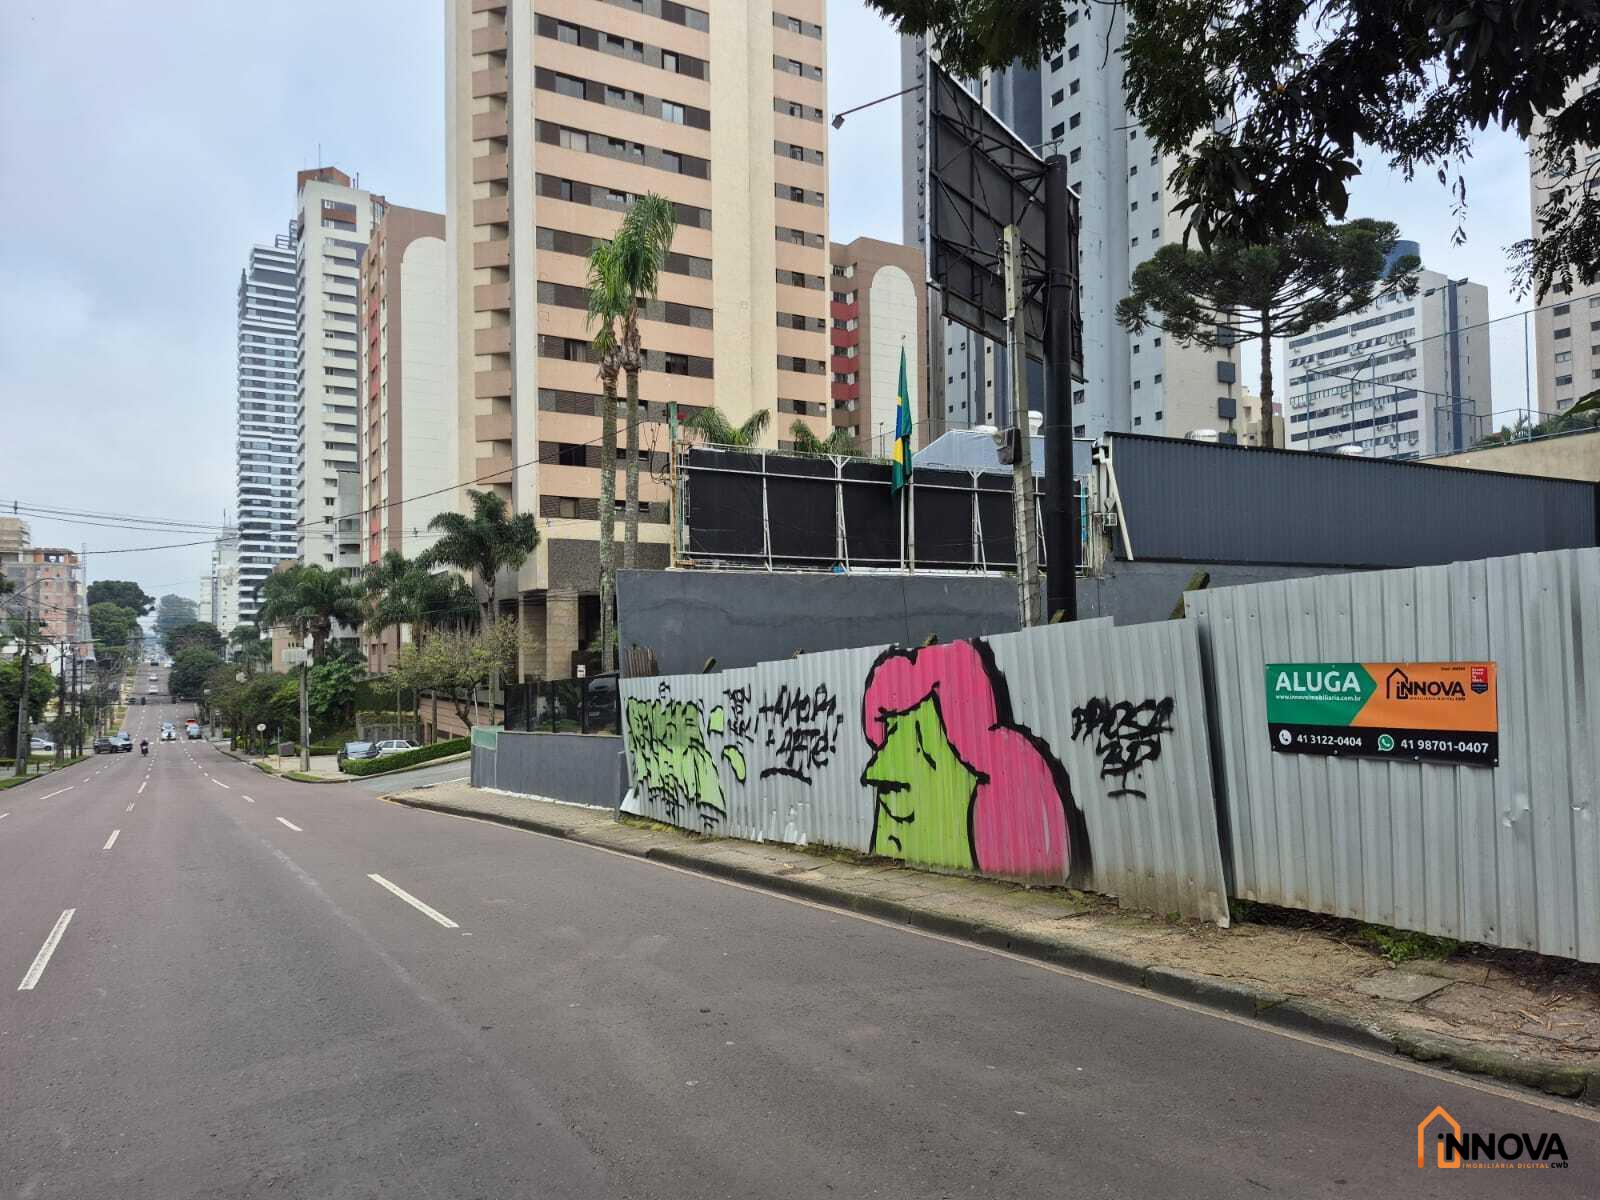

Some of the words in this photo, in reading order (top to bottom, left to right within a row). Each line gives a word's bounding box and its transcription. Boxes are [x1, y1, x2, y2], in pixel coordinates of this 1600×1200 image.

[1275, 671, 1361, 692] ALUGA
[1296, 734, 1308, 743] 41
[1310, 735, 1362, 747] 3122-0404
[1400, 739, 1414, 750] 41
[1417, 740, 1489, 753] 98701-0407
